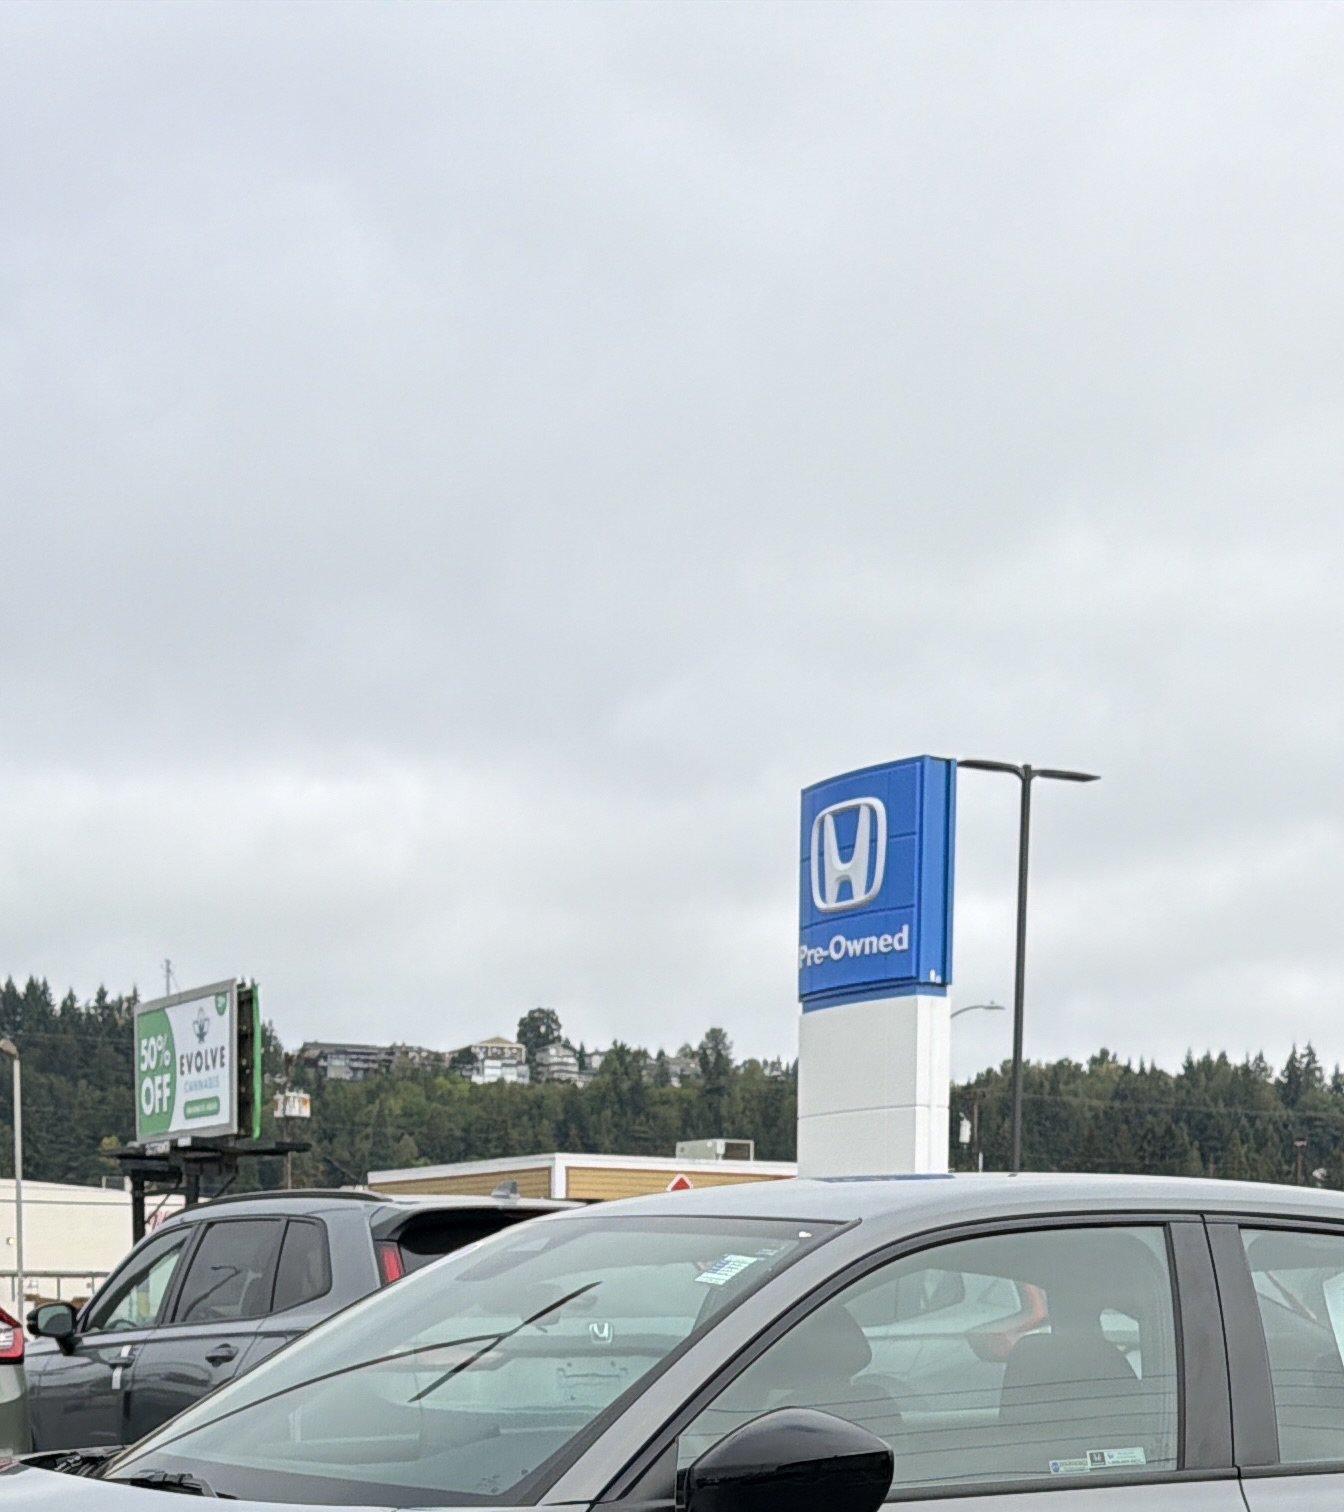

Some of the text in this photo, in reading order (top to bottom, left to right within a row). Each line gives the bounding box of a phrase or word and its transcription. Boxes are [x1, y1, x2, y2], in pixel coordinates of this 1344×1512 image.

[798, 923, 910, 969] Pre-Owned
[140, 1033, 172, 1072] 50%
[179, 1045, 226, 1077] EVOLVE
[141, 1073, 172, 1117] OFF
